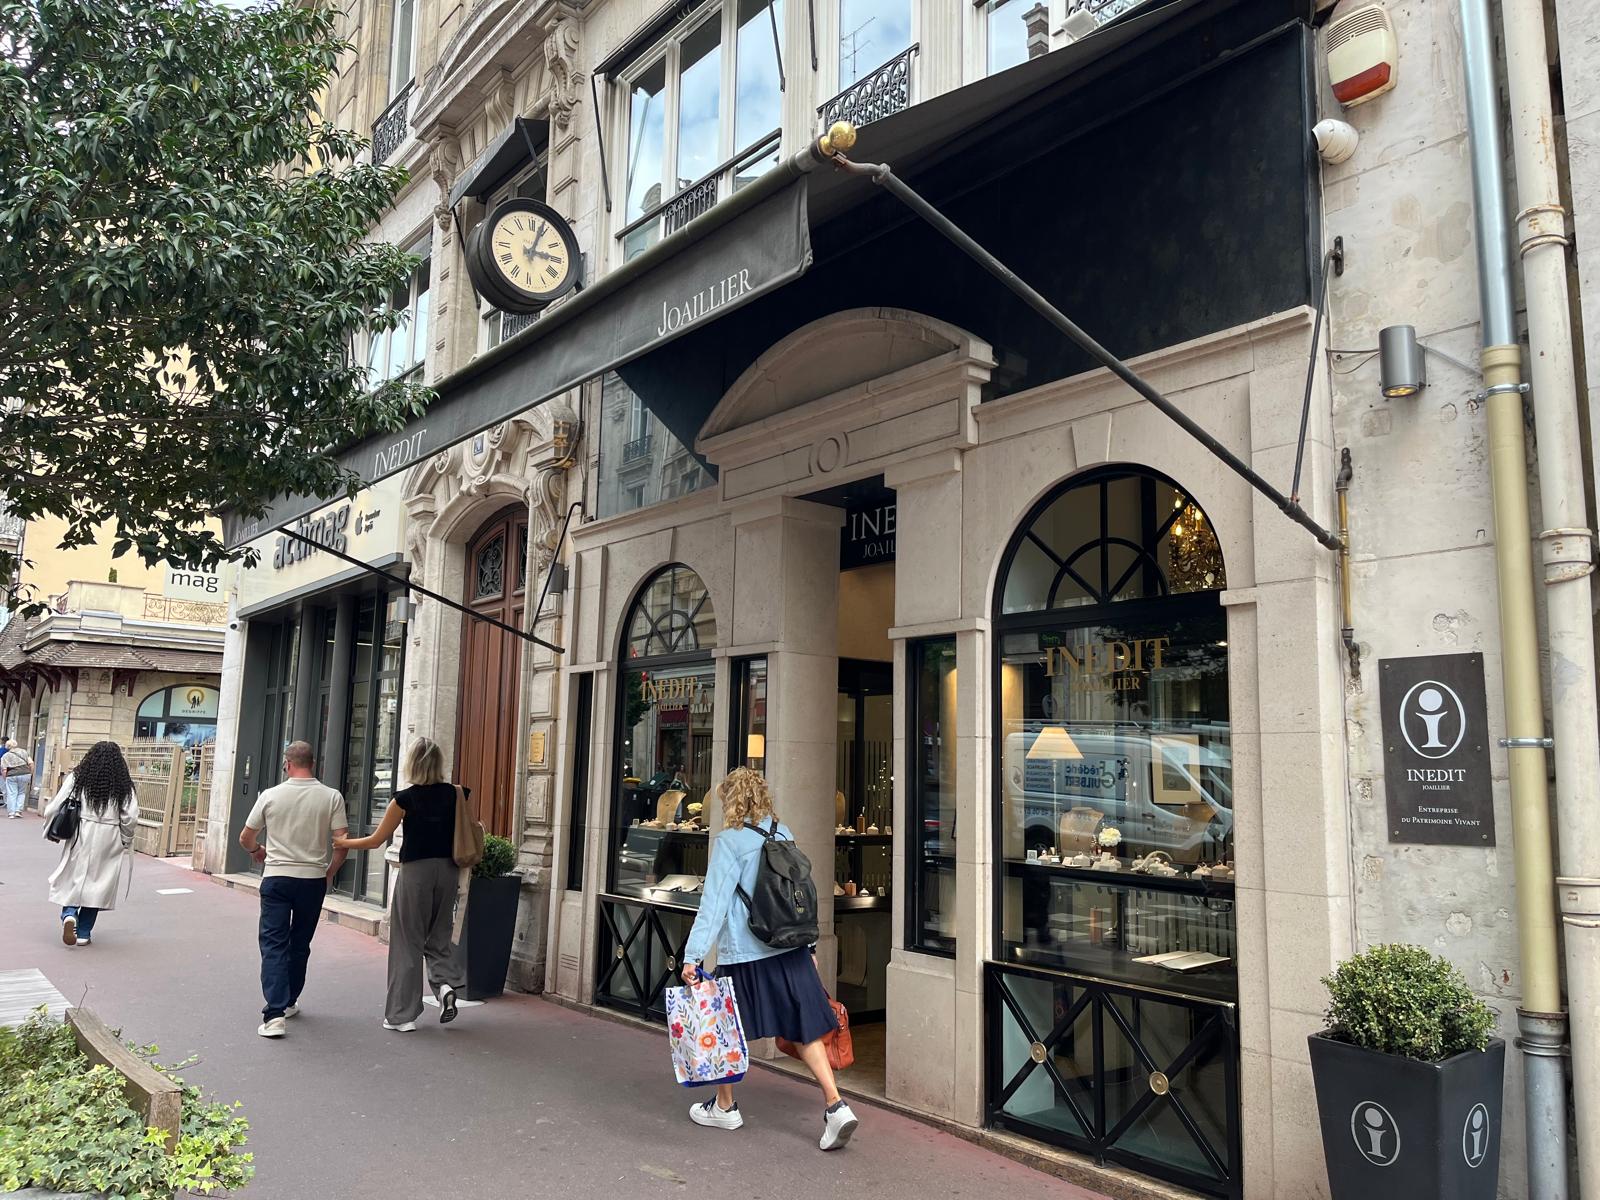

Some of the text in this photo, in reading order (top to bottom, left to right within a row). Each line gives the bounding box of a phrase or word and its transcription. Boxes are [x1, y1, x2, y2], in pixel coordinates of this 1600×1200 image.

[657, 267, 753, 337] JOAILLIER
[373, 428, 428, 479] INEDIT
[273, 504, 350, 570] actimag
[171, 573, 219, 593] mag
[1044, 636, 1170, 677] INEDIT
[641, 676, 698, 703] INEDIT
[1407, 768, 1466, 783] INEDIT
